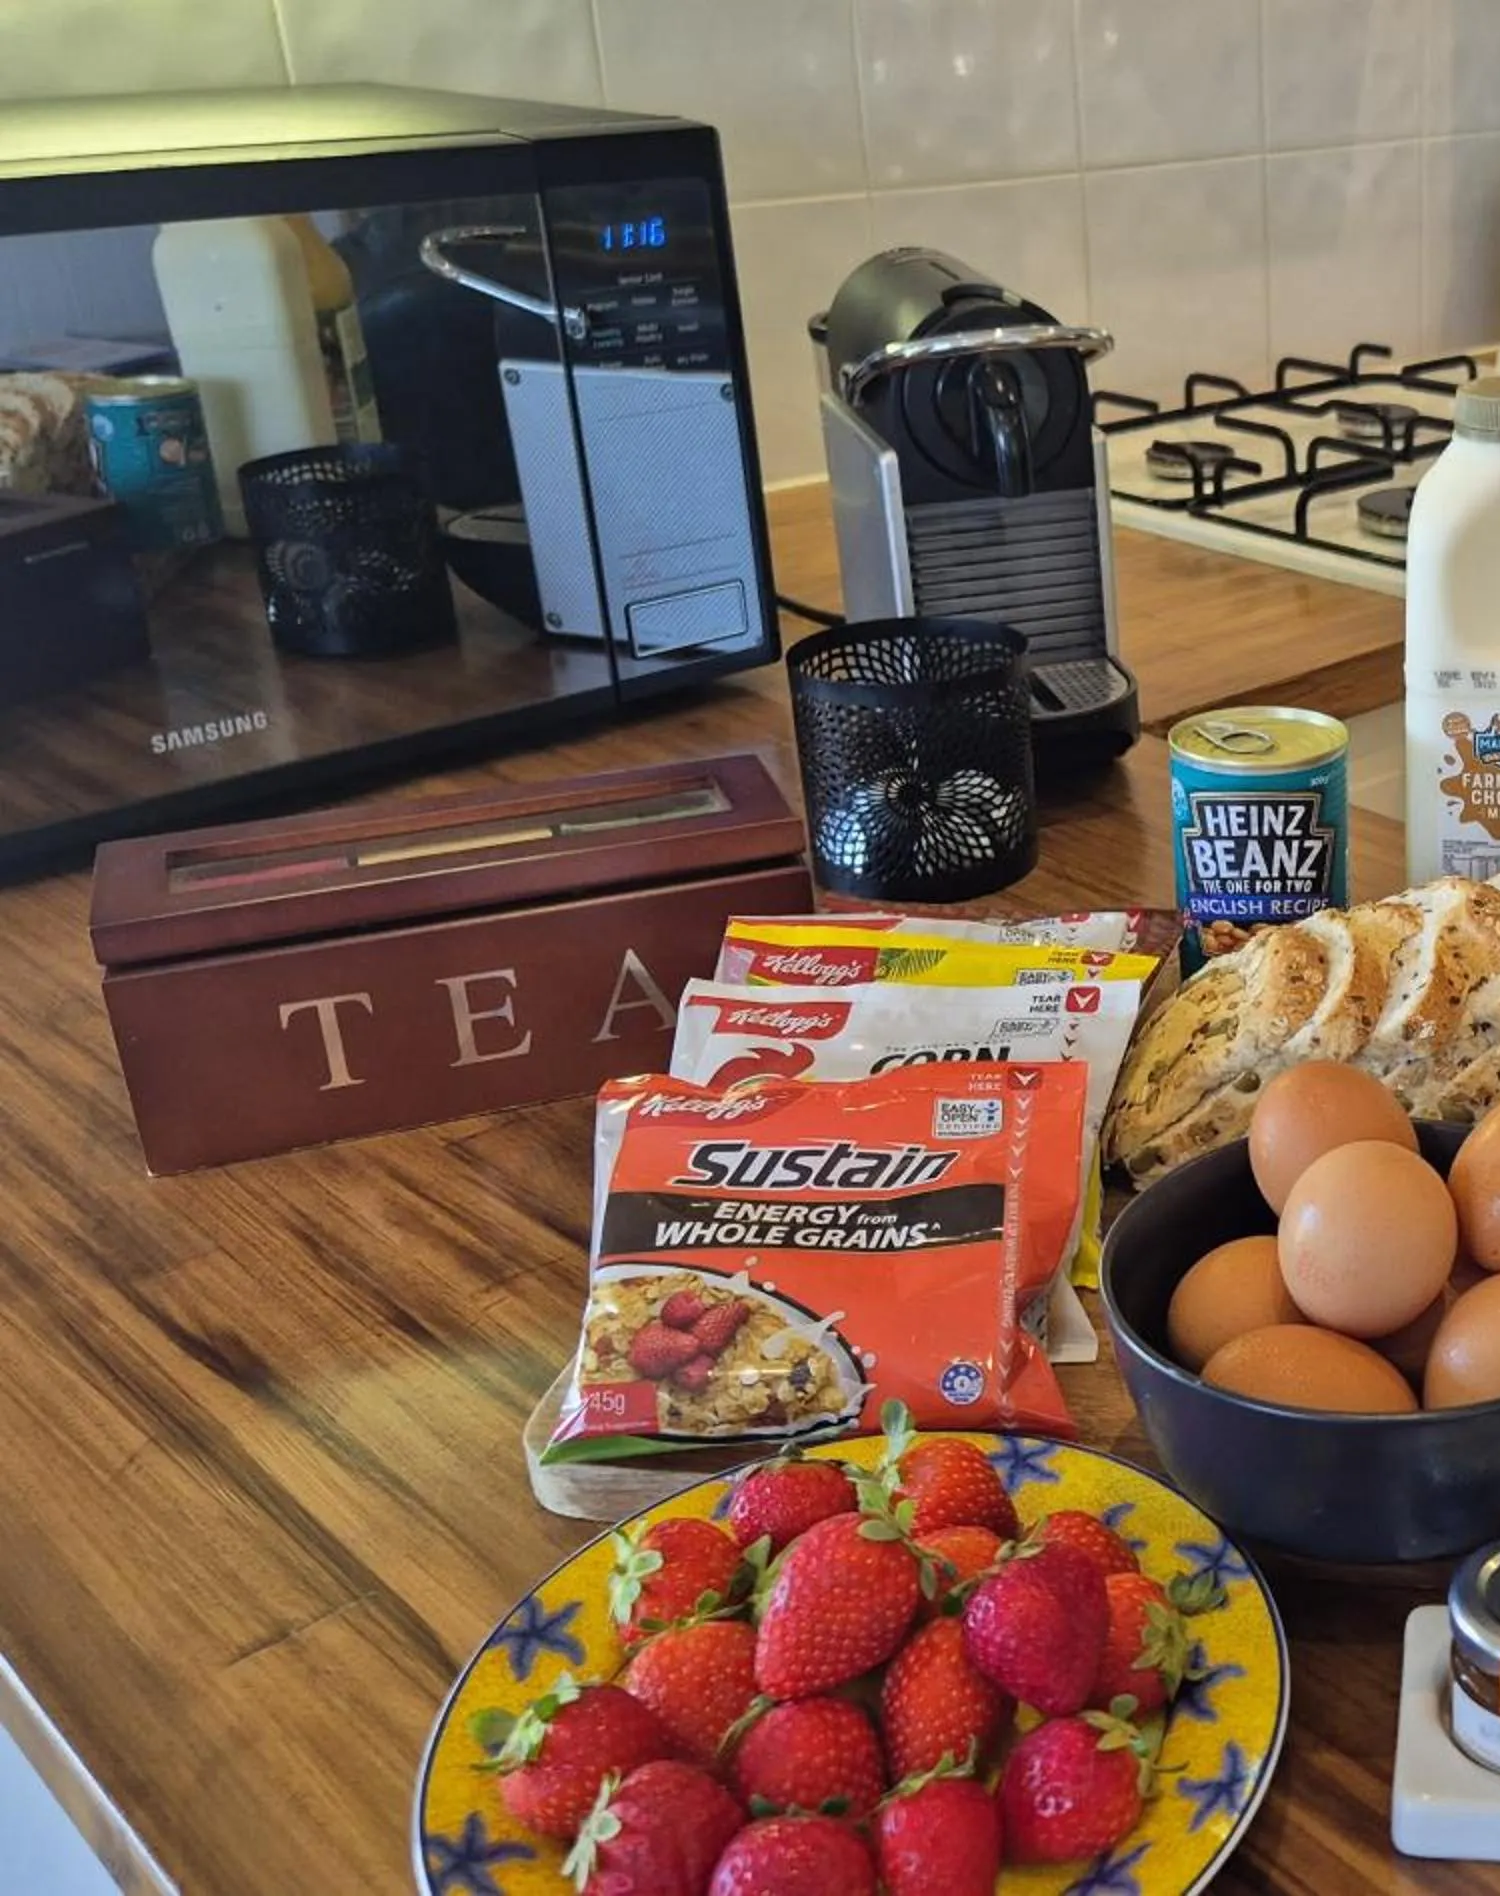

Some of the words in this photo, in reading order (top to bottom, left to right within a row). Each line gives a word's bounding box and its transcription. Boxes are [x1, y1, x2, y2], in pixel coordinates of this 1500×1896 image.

[151, 711, 268, 754] SAMSUNG
[1203, 805, 1306, 837] HEINZ
[1193, 839, 1323, 878] BEANZ
[1202, 879, 1221, 893] THE
[1226, 879, 1250, 894] ONE
[1255, 879, 1282, 893] FOR
[1287, 879, 1313, 893] TWO
[1191, 898, 1264, 915] ENGLISH
[762, 952, 863, 985] Kellogg's
[1029, 1004, 1060, 1012] HERE
[1032, 994, 1062, 1003] TEAR
[279, 948, 677, 1091] TEA
[727, 1008, 834, 1034] Kellogg's
[639, 1093, 768, 1120] Kellogg's
[670, 1141, 959, 1189] Sustain
[713, 1201, 861, 1226] ENERGY
[857, 1213, 898, 1225] from
[654, 1220, 790, 1248] WHOLE
